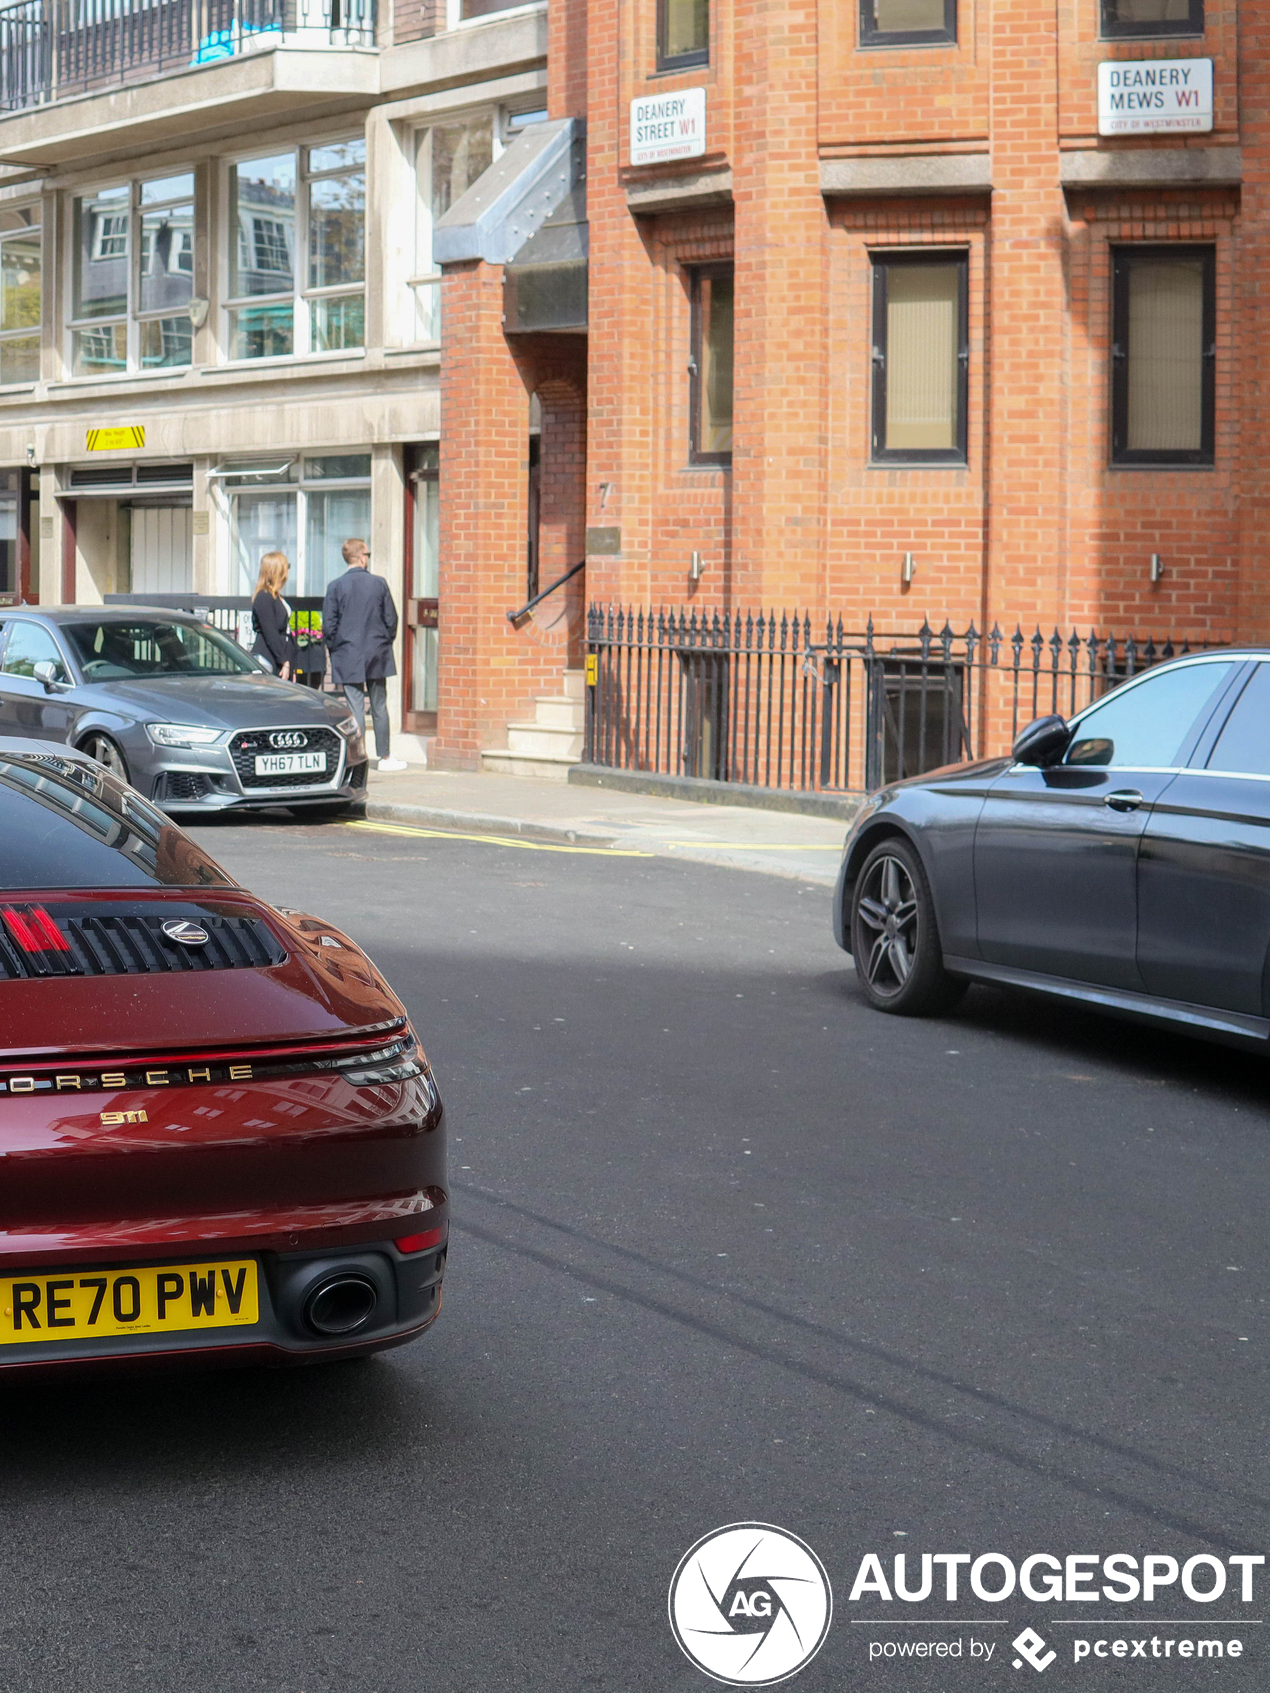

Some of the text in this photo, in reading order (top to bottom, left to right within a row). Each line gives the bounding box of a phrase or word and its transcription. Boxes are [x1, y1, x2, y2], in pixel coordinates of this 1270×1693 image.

[1110, 67, 1192, 87] DEANERY
[637, 98, 686, 122] DEANERY
[1110, 90, 1199, 110] MEWS W1
[636, 117, 696, 142] STREET W1
[1111, 118, 1201, 130] CITY OF WESTMINSTER
[599, 482, 610, 509] 7
[261, 754, 320, 772] YH67 TLN
[99, 1109, 148, 1126] 911
[12, 1267, 247, 1331] RE70 PWV
